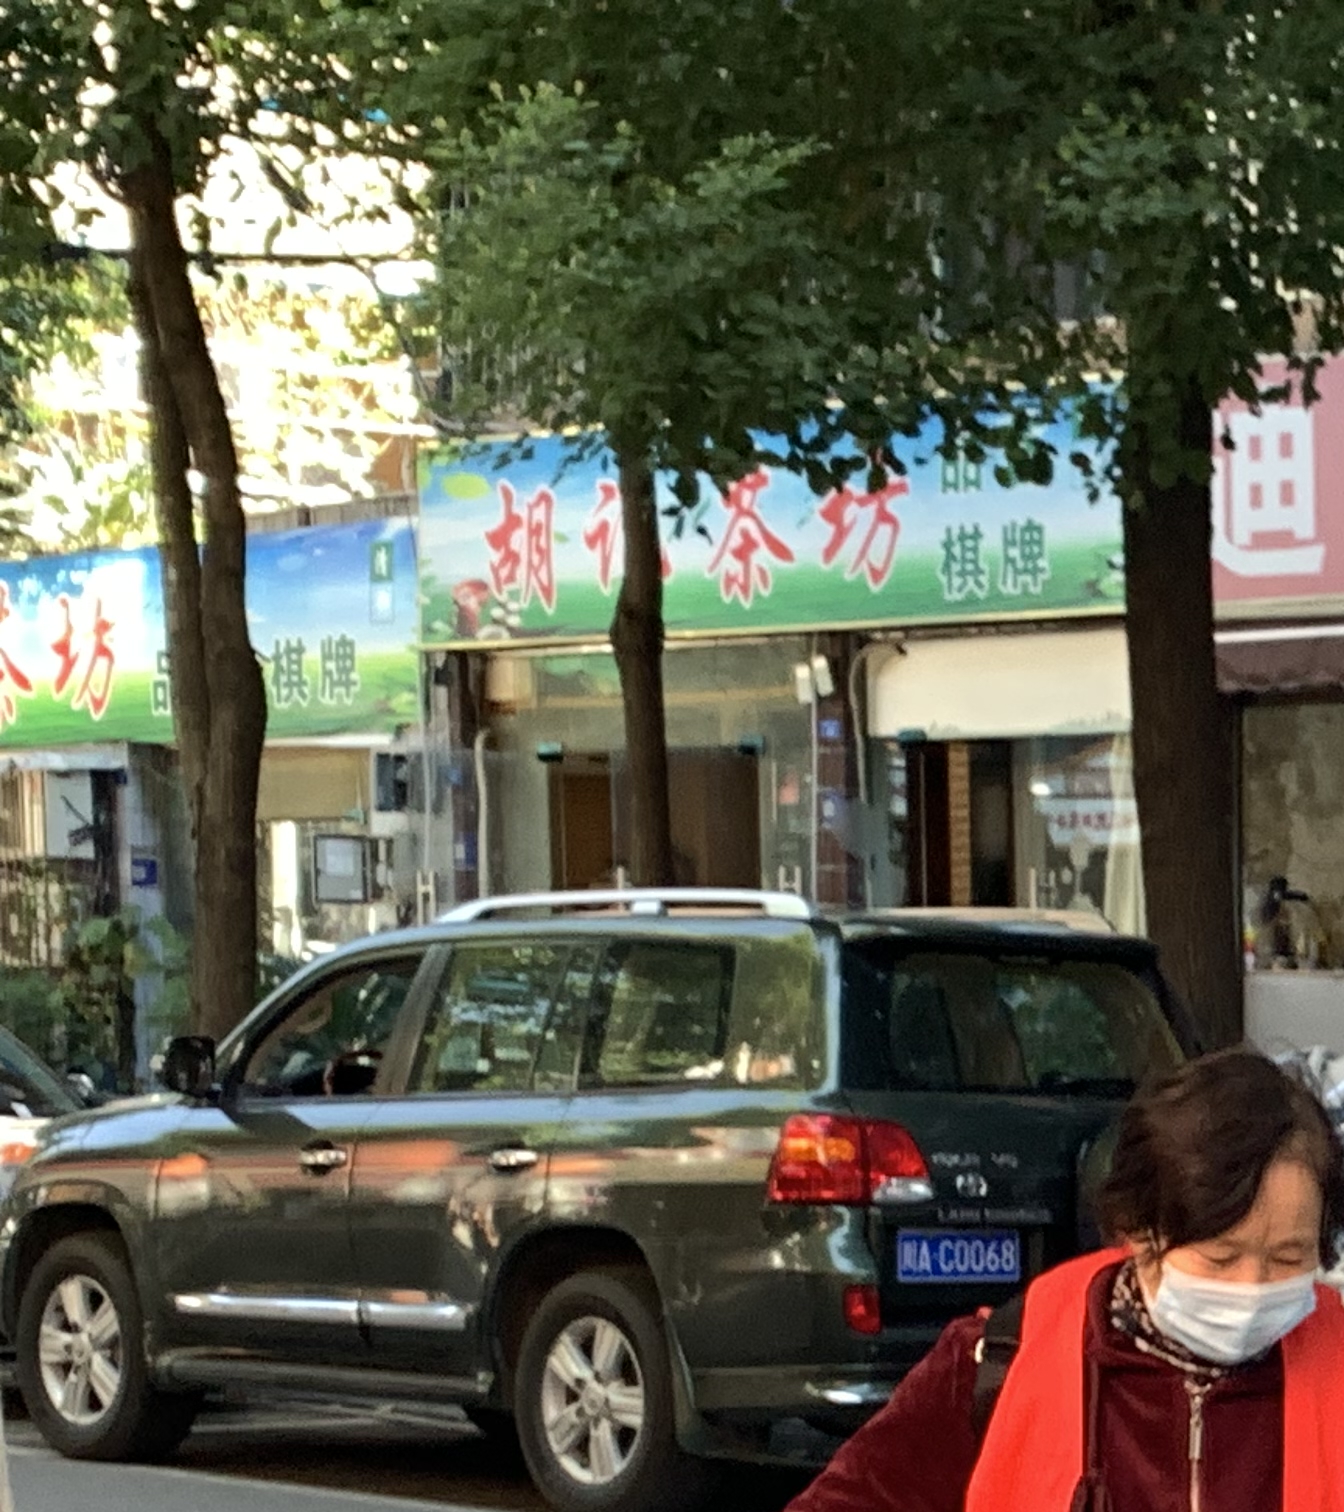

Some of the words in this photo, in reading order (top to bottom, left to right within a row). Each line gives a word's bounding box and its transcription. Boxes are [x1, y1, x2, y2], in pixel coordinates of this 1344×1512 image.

[485, 455, 909, 608] 胡茶坊
[940, 516, 1047, 596] 棋牌
